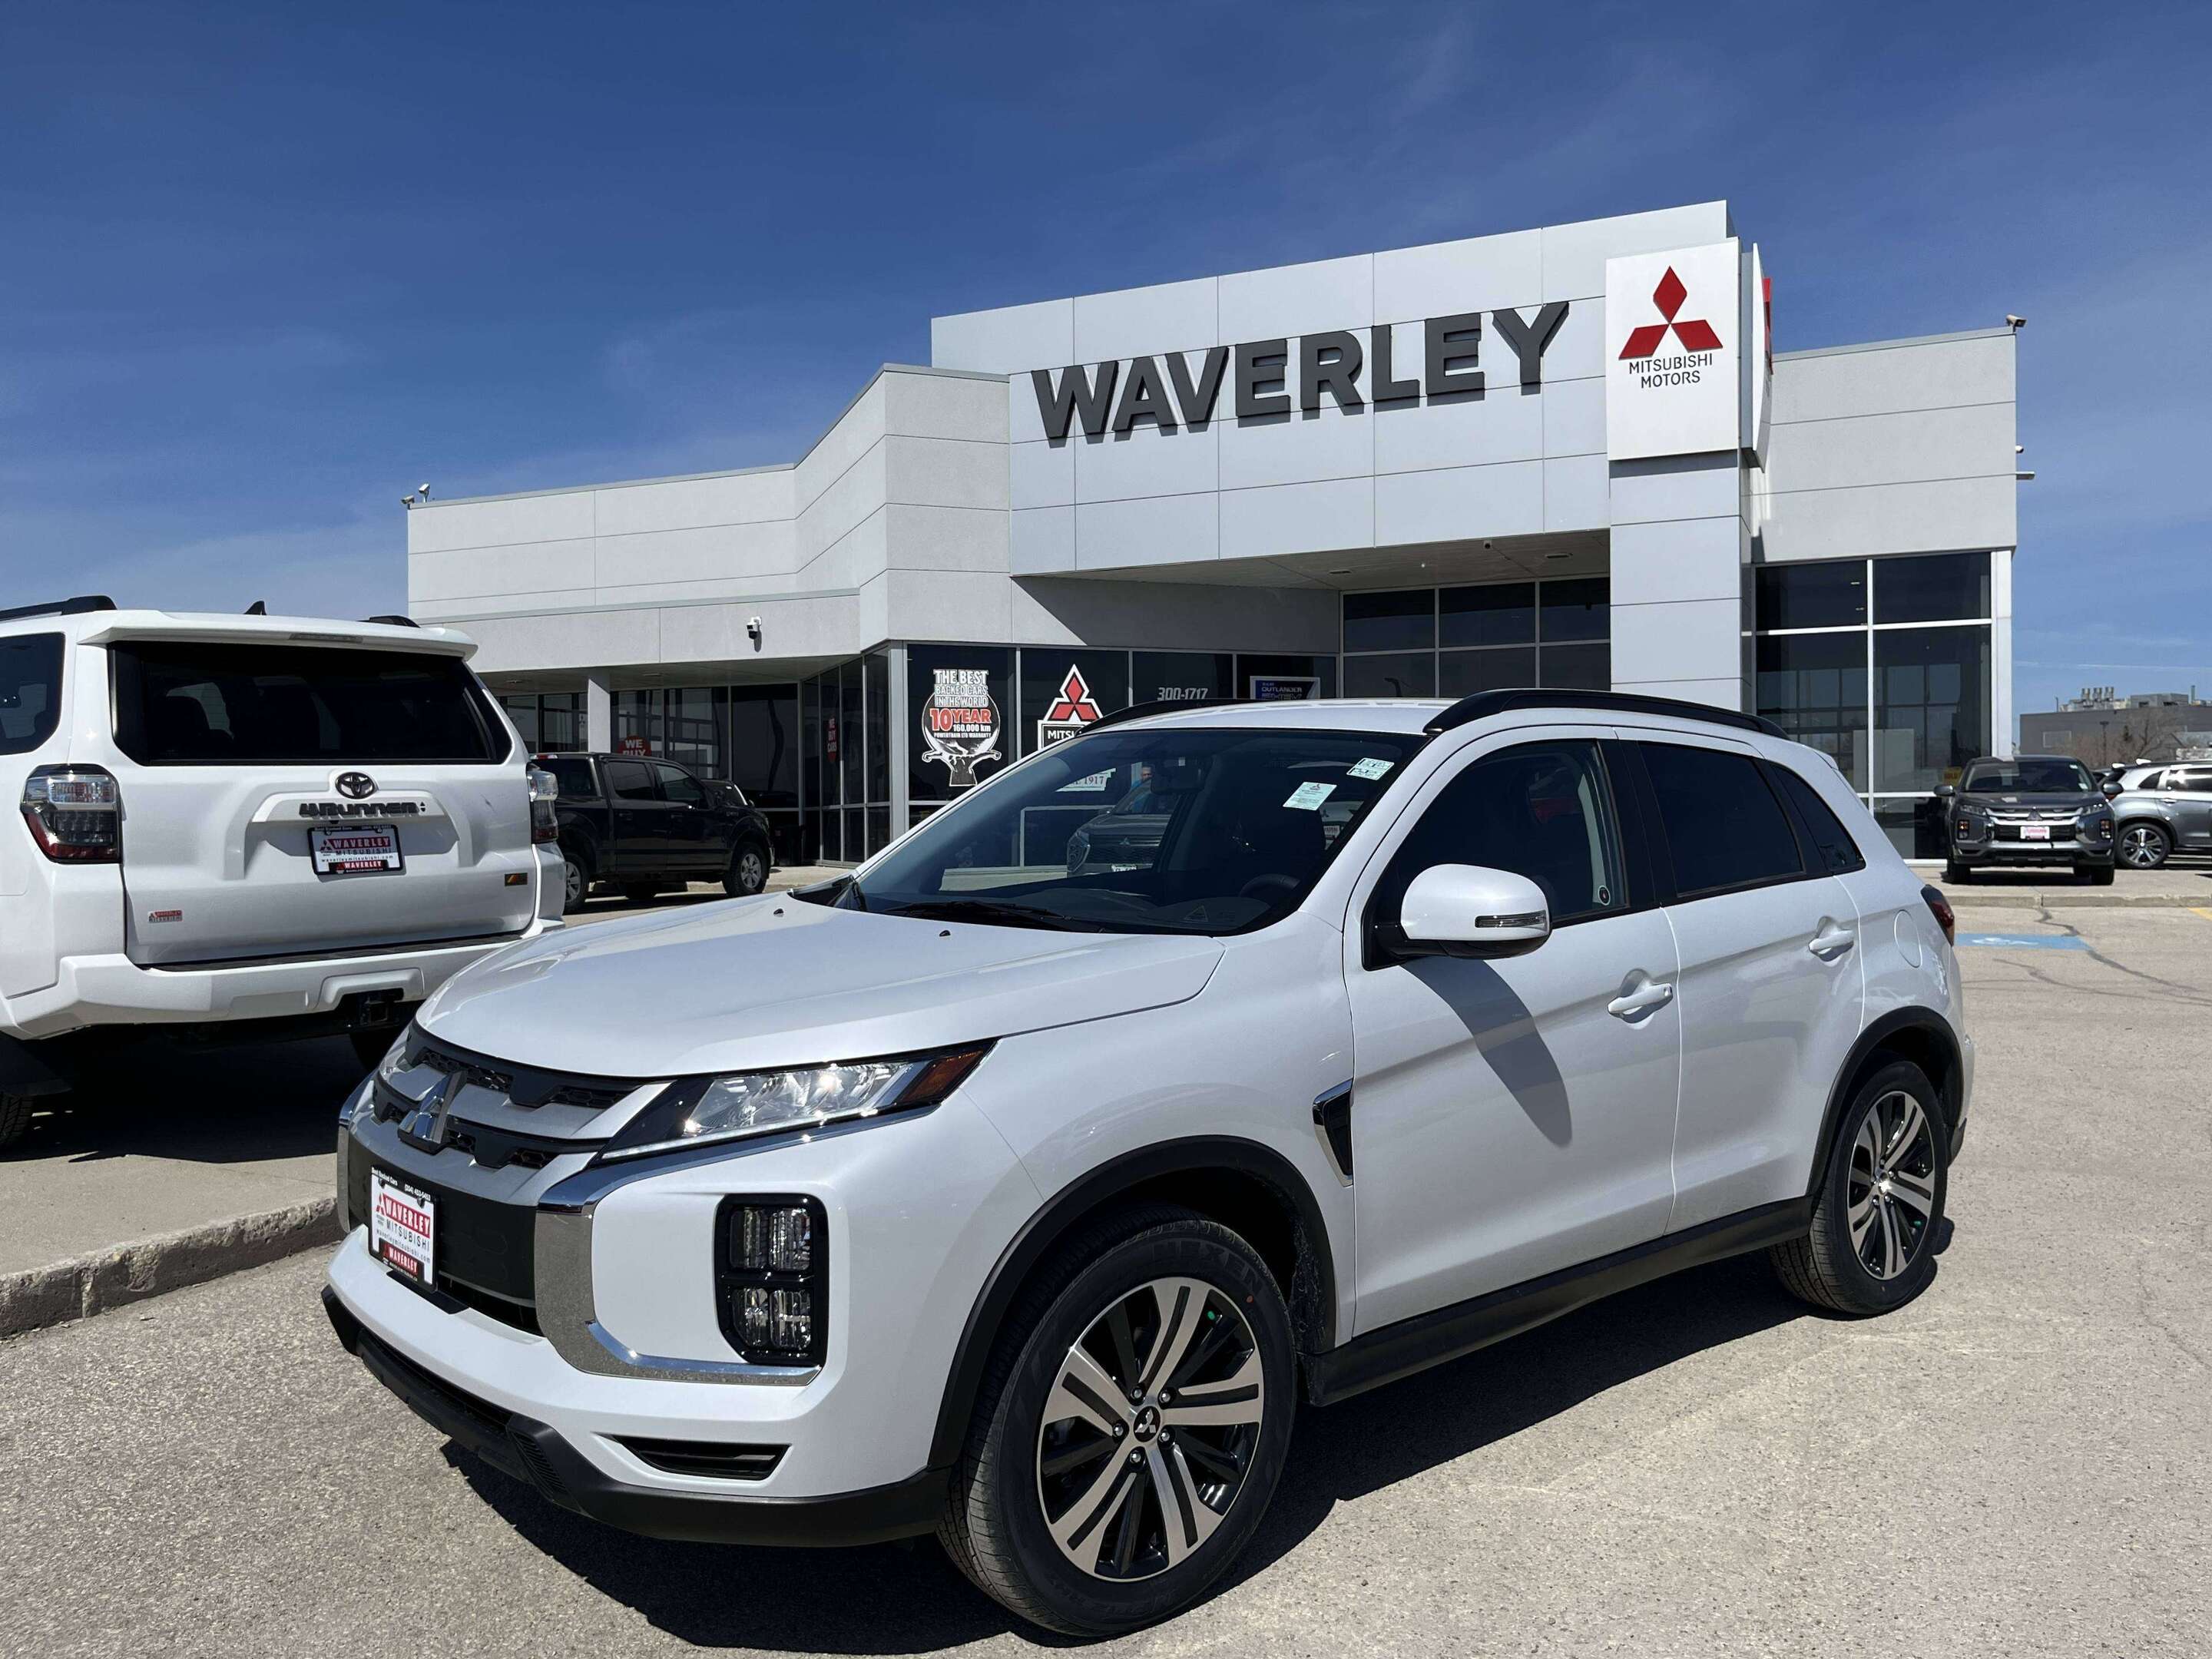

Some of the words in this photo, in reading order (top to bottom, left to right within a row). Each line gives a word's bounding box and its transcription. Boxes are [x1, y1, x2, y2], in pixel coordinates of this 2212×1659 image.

[1031, 301, 1569, 440] WAVERLEY
[1629, 353, 1713, 374] MITSUBISHI
[1641, 370, 1700, 389] MOTORS
[933, 669, 957, 684] THE
[958, 669, 988, 684] BEST
[935, 684, 965, 695] BACKED
[966, 684, 988, 696] CARS
[1157, 687, 1208, 700] 300-1717
[935, 696, 944, 707] IN
[944, 696, 960, 707] THE
[960, 696, 988, 707] WORLD
[929, 708, 953, 731] 10
[951, 708, 992, 724] YEAR
[980, 724, 992, 732] km
[625, 740, 643, 748] WE
[1084, 776, 1104, 784] 1917
[333, 837, 389, 849] WAVERLEY
[336, 847, 392, 856] MITSUBISHI
[385, 1197, 430, 1235] WAVERLEY
[386, 1218, 430, 1252] MITSUBISHI
[389, 1246, 418, 1273] WAVERLEY
